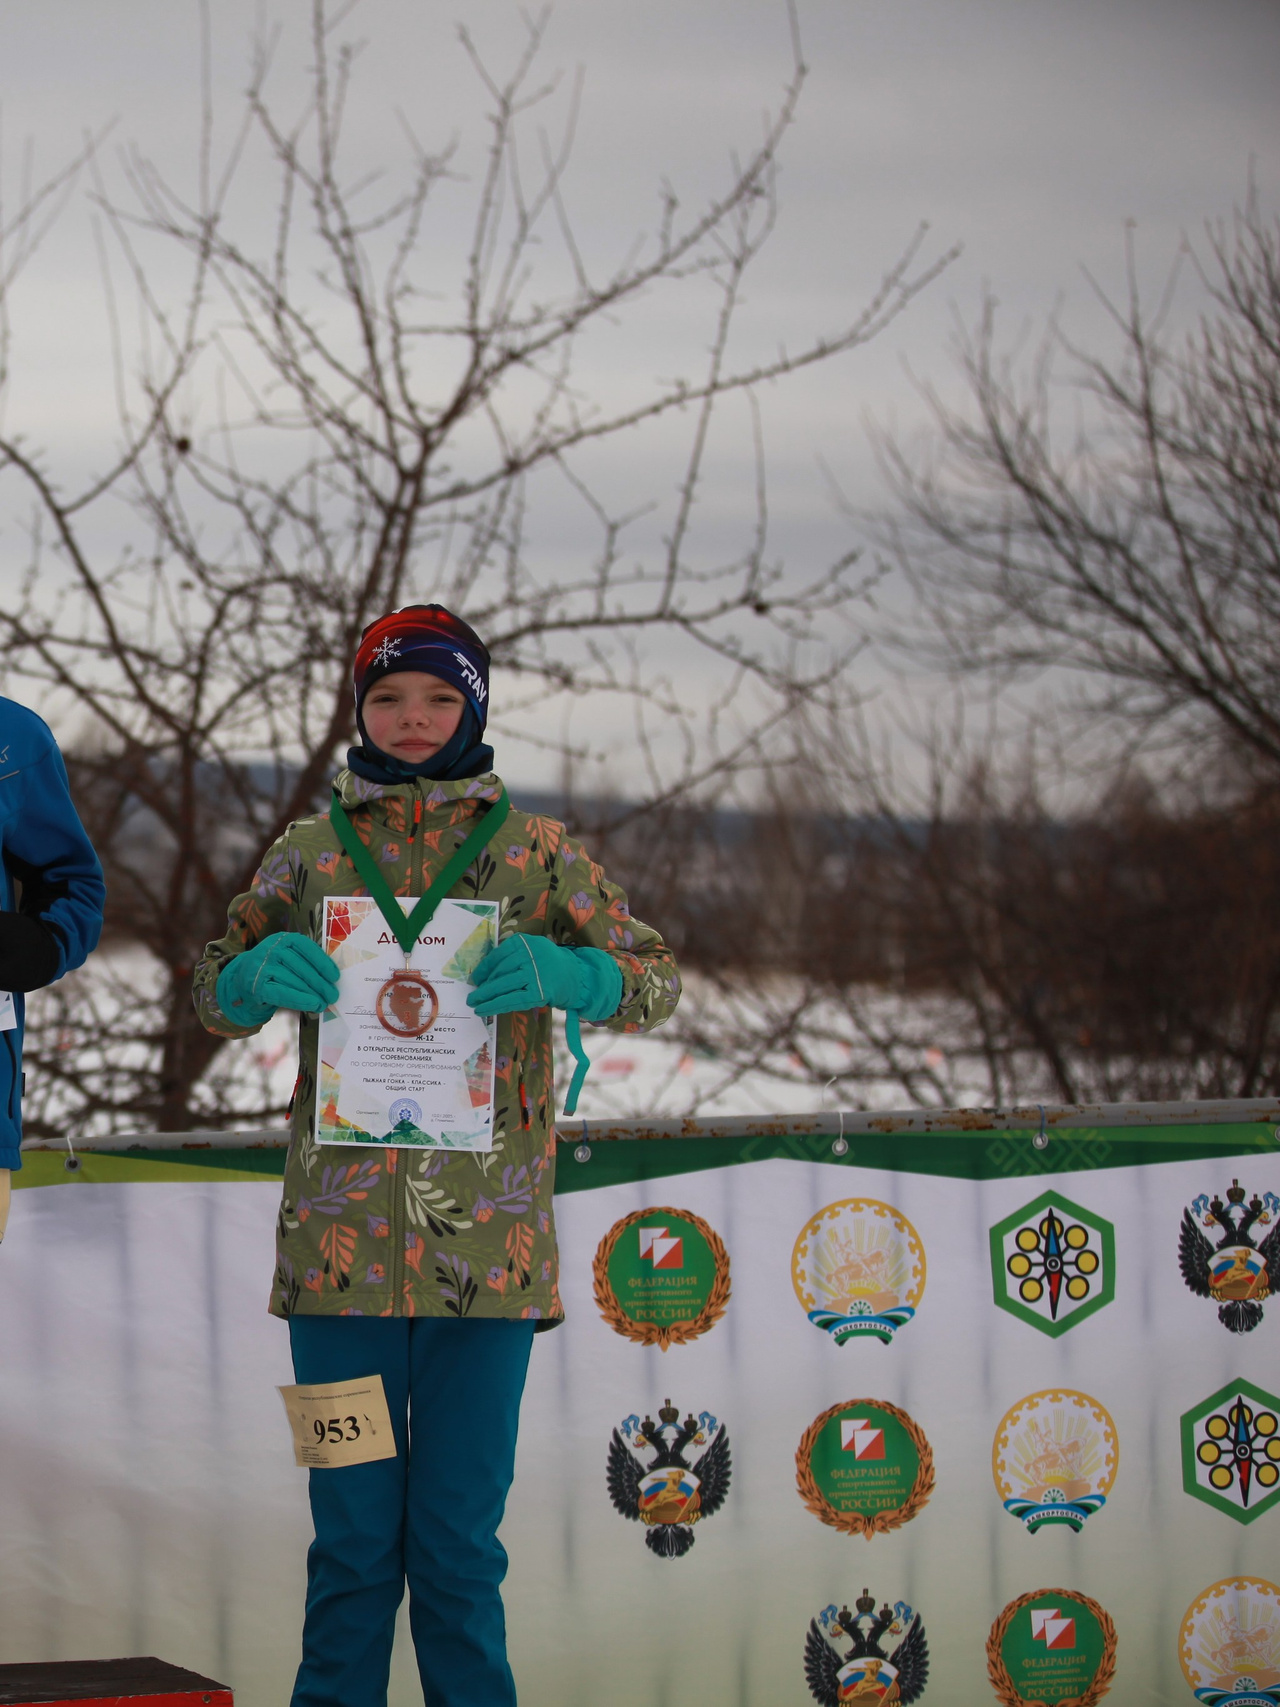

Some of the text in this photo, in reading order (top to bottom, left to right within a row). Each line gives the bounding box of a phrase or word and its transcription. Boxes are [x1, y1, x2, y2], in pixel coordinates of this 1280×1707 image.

[453, 652, 487, 703] RAY
[416, 1034, 435, 1042] Ж-12
[363, 1045, 395, 1053] ОТКРЫТЫХ
[396, 1047, 456, 1055] РЕСПУБЛИКАНСКИХ
[380, 1054, 433, 1062] СОРЕВНОВАНИЯХ
[628, 1276, 697, 1288] ФЕДЕРАЦИЯ
[634, 1290, 692, 1298] спортивного
[636, 1308, 692, 1319] РОССИИ
[834, 1323, 892, 1336] БАШКОРТОСТАН
[313, 1416, 361, 1444] 953
[830, 1466, 900, 1479] ФЕДЕРАЦИЯ
[837, 1480, 896, 1489] спортивного
[841, 1498, 897, 1509] РОССИИ
[1027, 1511, 1083, 1524] БАШКОРТОСТАН
[1022, 1655, 1086, 1668] ФЕДЕРАЦИЯ
[1027, 1686, 1079, 1698] РОССИИ
